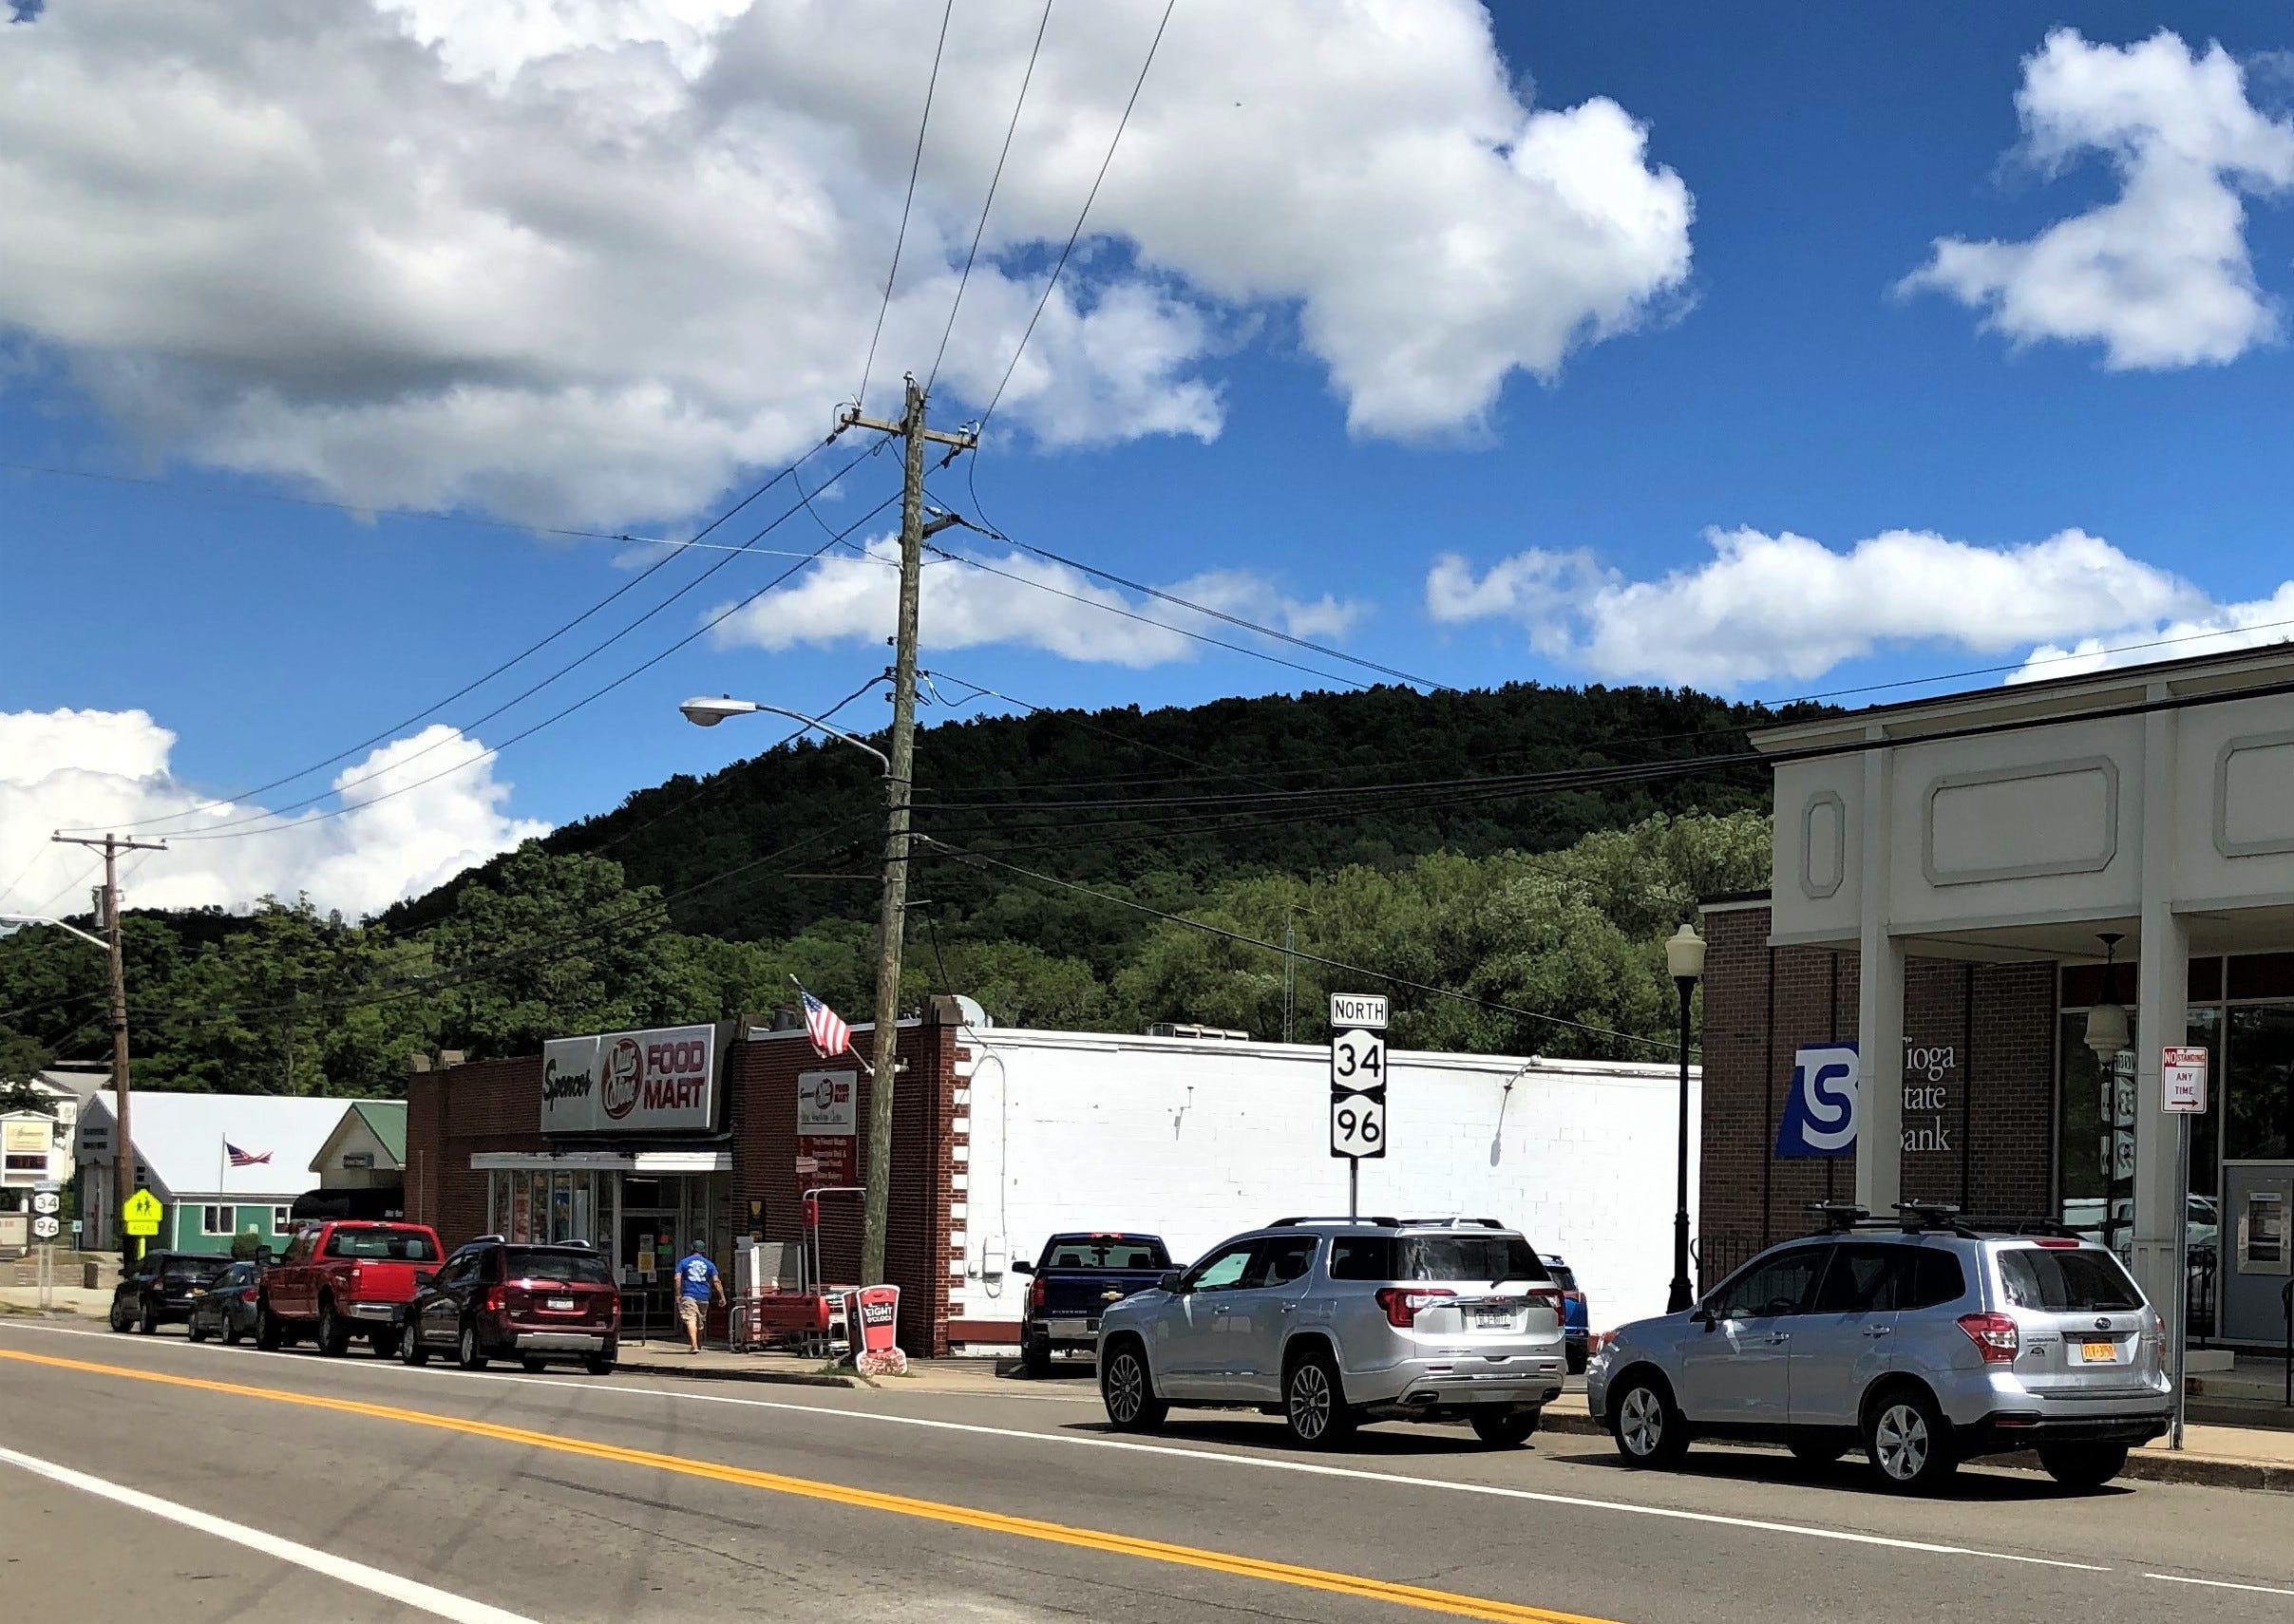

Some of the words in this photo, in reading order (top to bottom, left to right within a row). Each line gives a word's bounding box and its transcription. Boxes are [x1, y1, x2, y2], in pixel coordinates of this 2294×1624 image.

[1335, 999, 1384, 1021] NORTH
[647, 1041, 705, 1075] FOOD
[1337, 1043, 1381, 1078] 34
[1903, 1036, 1956, 1082] ioga
[2165, 1051, 2176, 1064] NO
[2175, 1072, 2193, 1082] ANY
[643, 1077, 706, 1110] MART
[1901, 1086, 1945, 1110] tate
[2175, 1086, 2194, 1096] TIME
[1337, 1108, 1380, 1142] 96
[1901, 1115, 1951, 1152] ank
[37, 1197, 57, 1210] 34
[36, 1220, 57, 1234] 96
[863, 1305, 893, 1317] EIGHT
